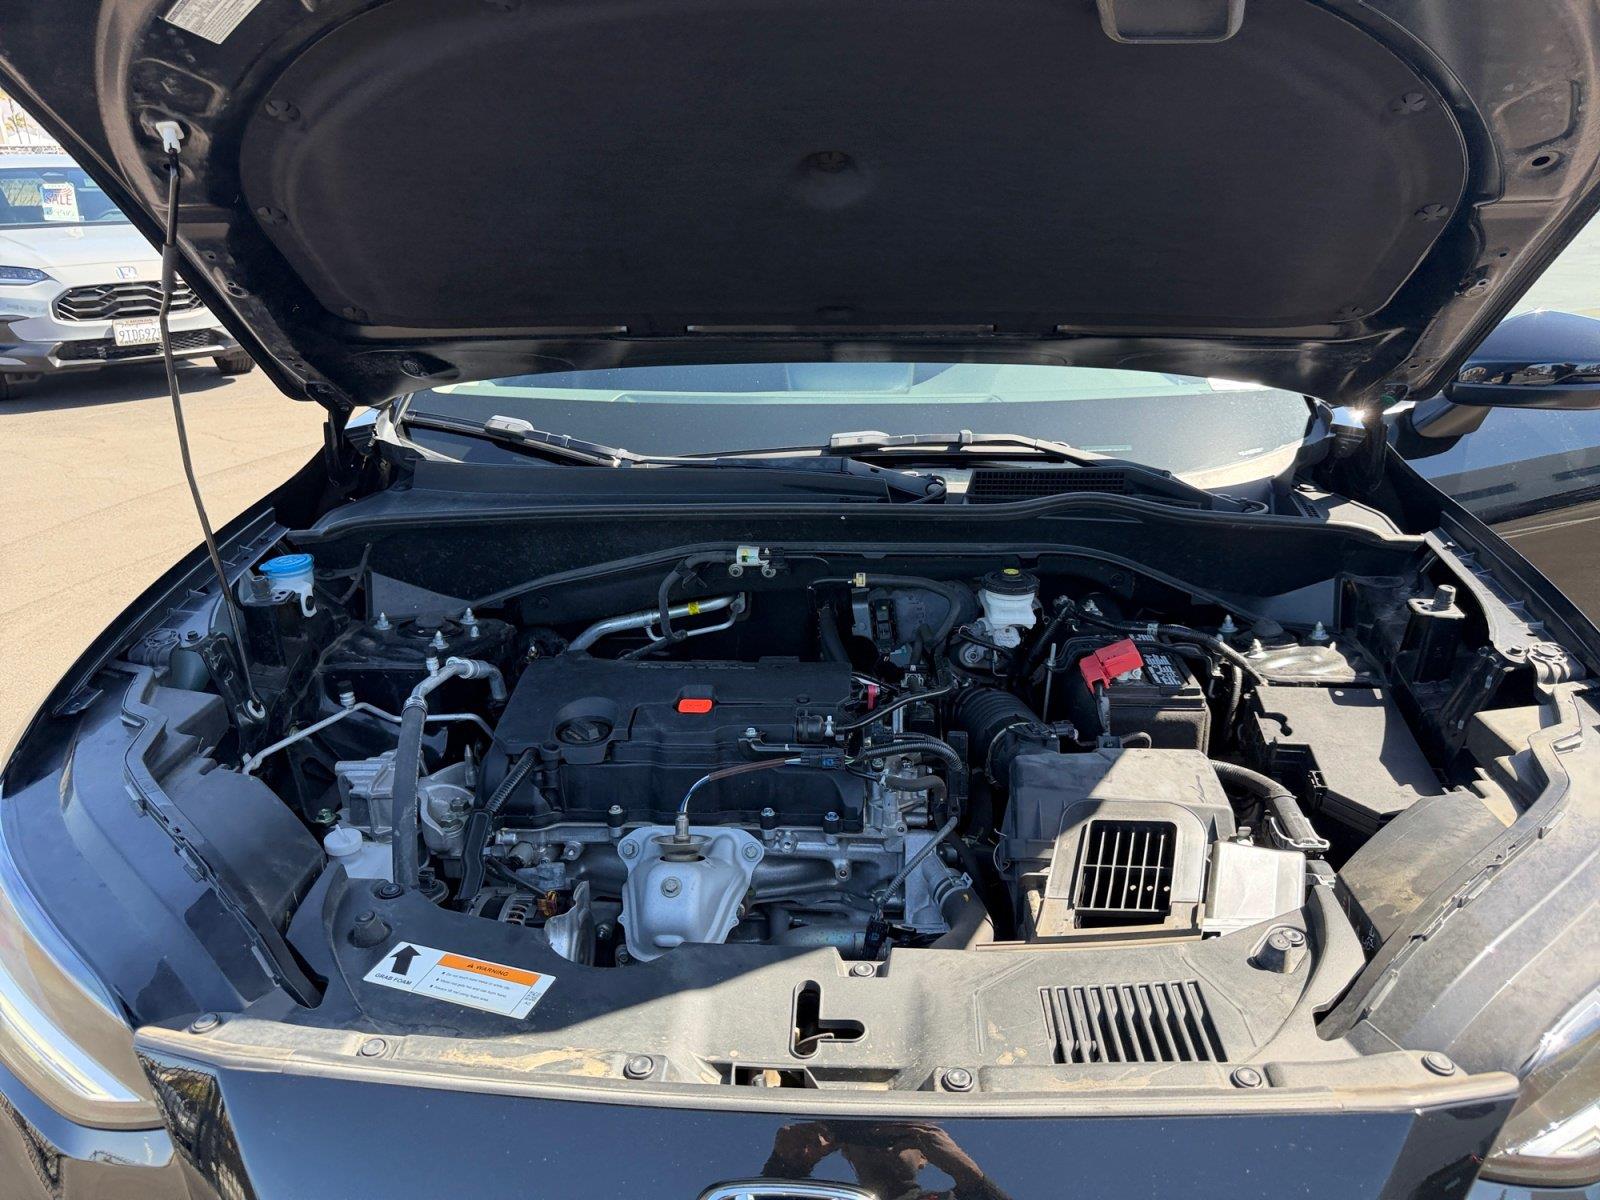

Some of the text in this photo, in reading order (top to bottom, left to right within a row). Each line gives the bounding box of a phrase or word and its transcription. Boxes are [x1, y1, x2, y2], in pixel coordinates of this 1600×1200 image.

[43, 192, 73, 206] SALE
[475, 965, 510, 977] WARNING
[374, 972, 413, 985] GRAB FOAM
